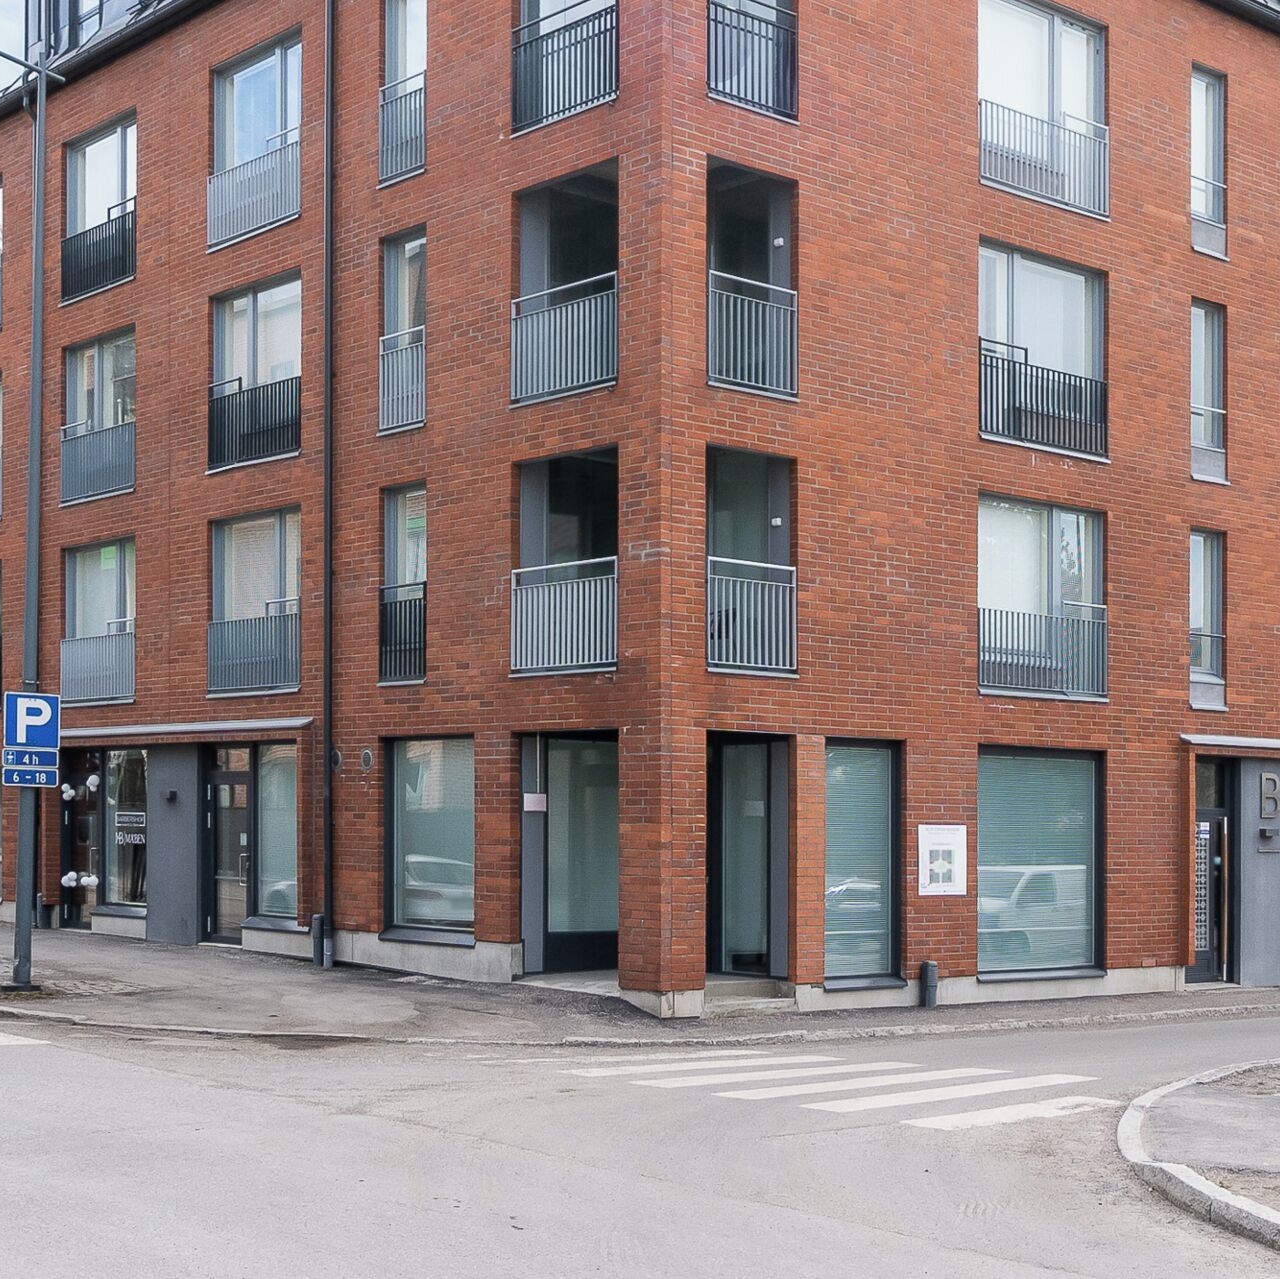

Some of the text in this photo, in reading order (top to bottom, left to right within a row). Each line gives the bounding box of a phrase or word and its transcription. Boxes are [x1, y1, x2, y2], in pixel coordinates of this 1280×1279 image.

[17, 697, 52, 743] P
[22, 754, 39, 765] 4 h
[12, 772, 19, 782] 6
[35, 773, 47, 784] 18
[1260, 772, 1280, 819] B
